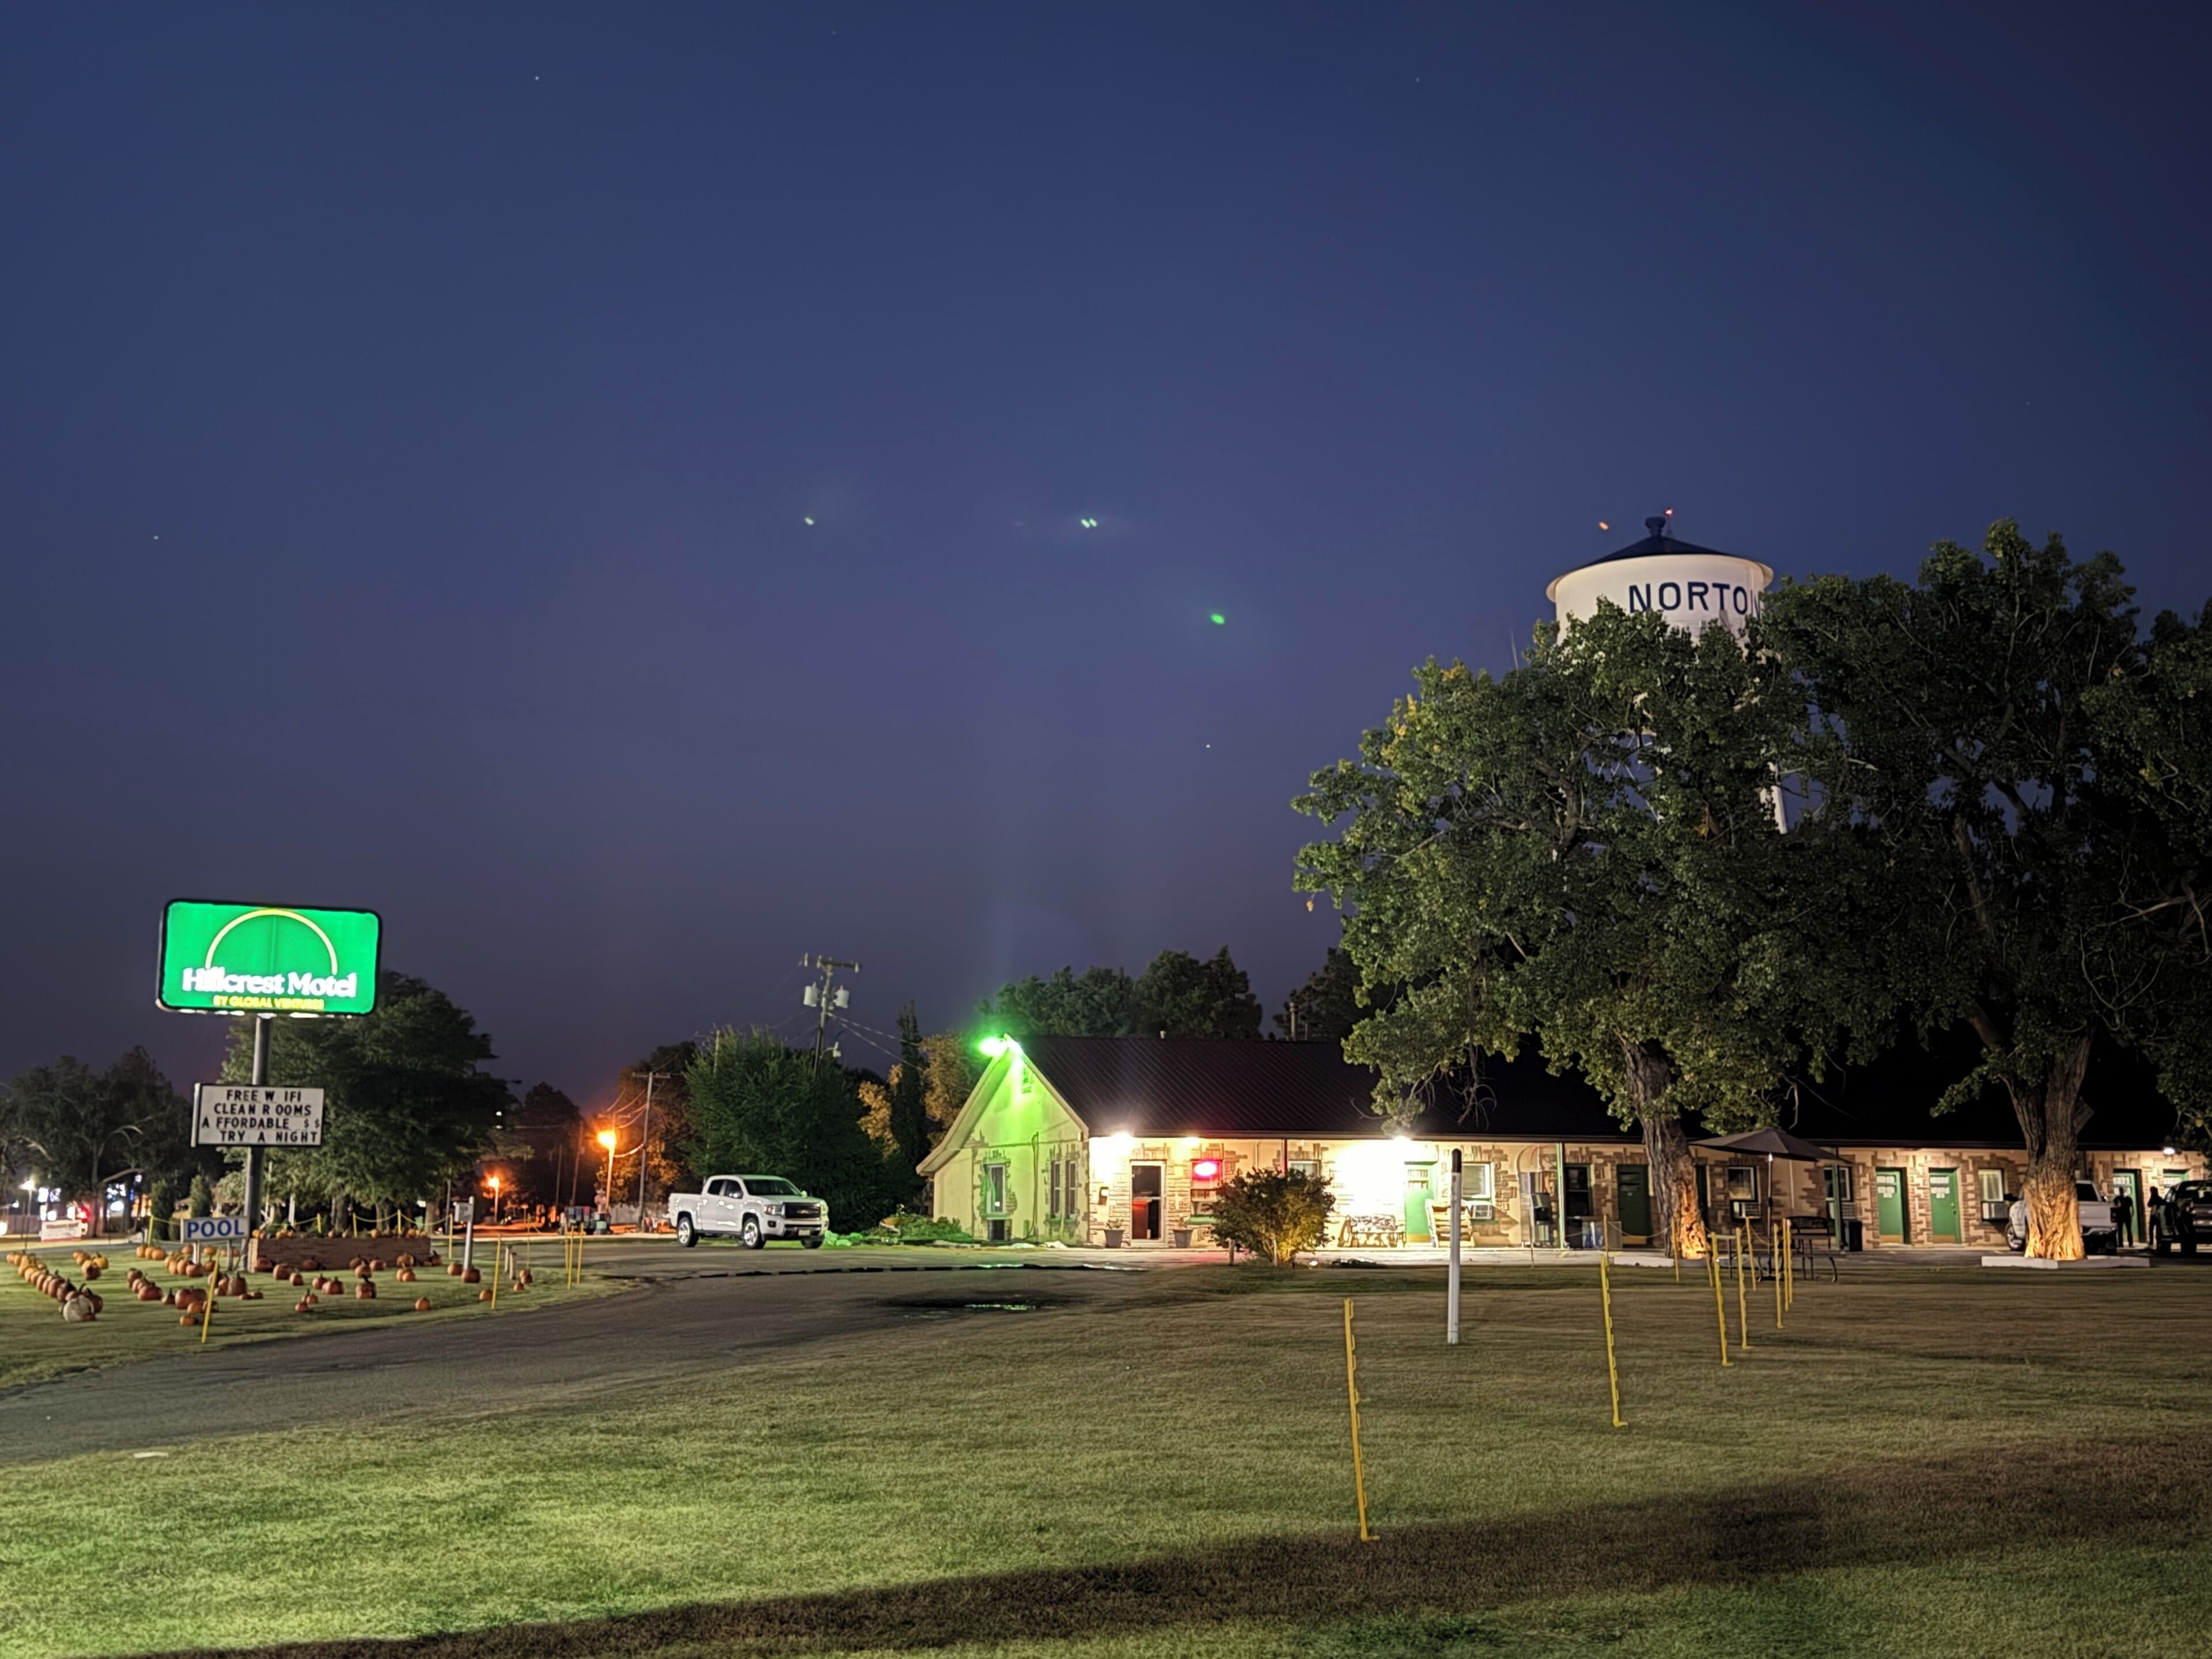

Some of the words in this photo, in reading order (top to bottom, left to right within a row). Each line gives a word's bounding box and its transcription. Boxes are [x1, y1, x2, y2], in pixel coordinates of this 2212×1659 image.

[182, 966, 285, 995] Hillcrest
[287, 971, 357, 998] Motel
[213, 995, 228, 1006] BY
[229, 995, 273, 1008] GLOBAL
[226, 1089, 258, 1101] FREE
[214, 1103, 256, 1115] CLEAN
[220, 1131, 245, 1142] TRY
[257, 1131, 265, 1142] A
[276, 1131, 317, 1143] NIGHT
[187, 1219, 244, 1238] POOL
